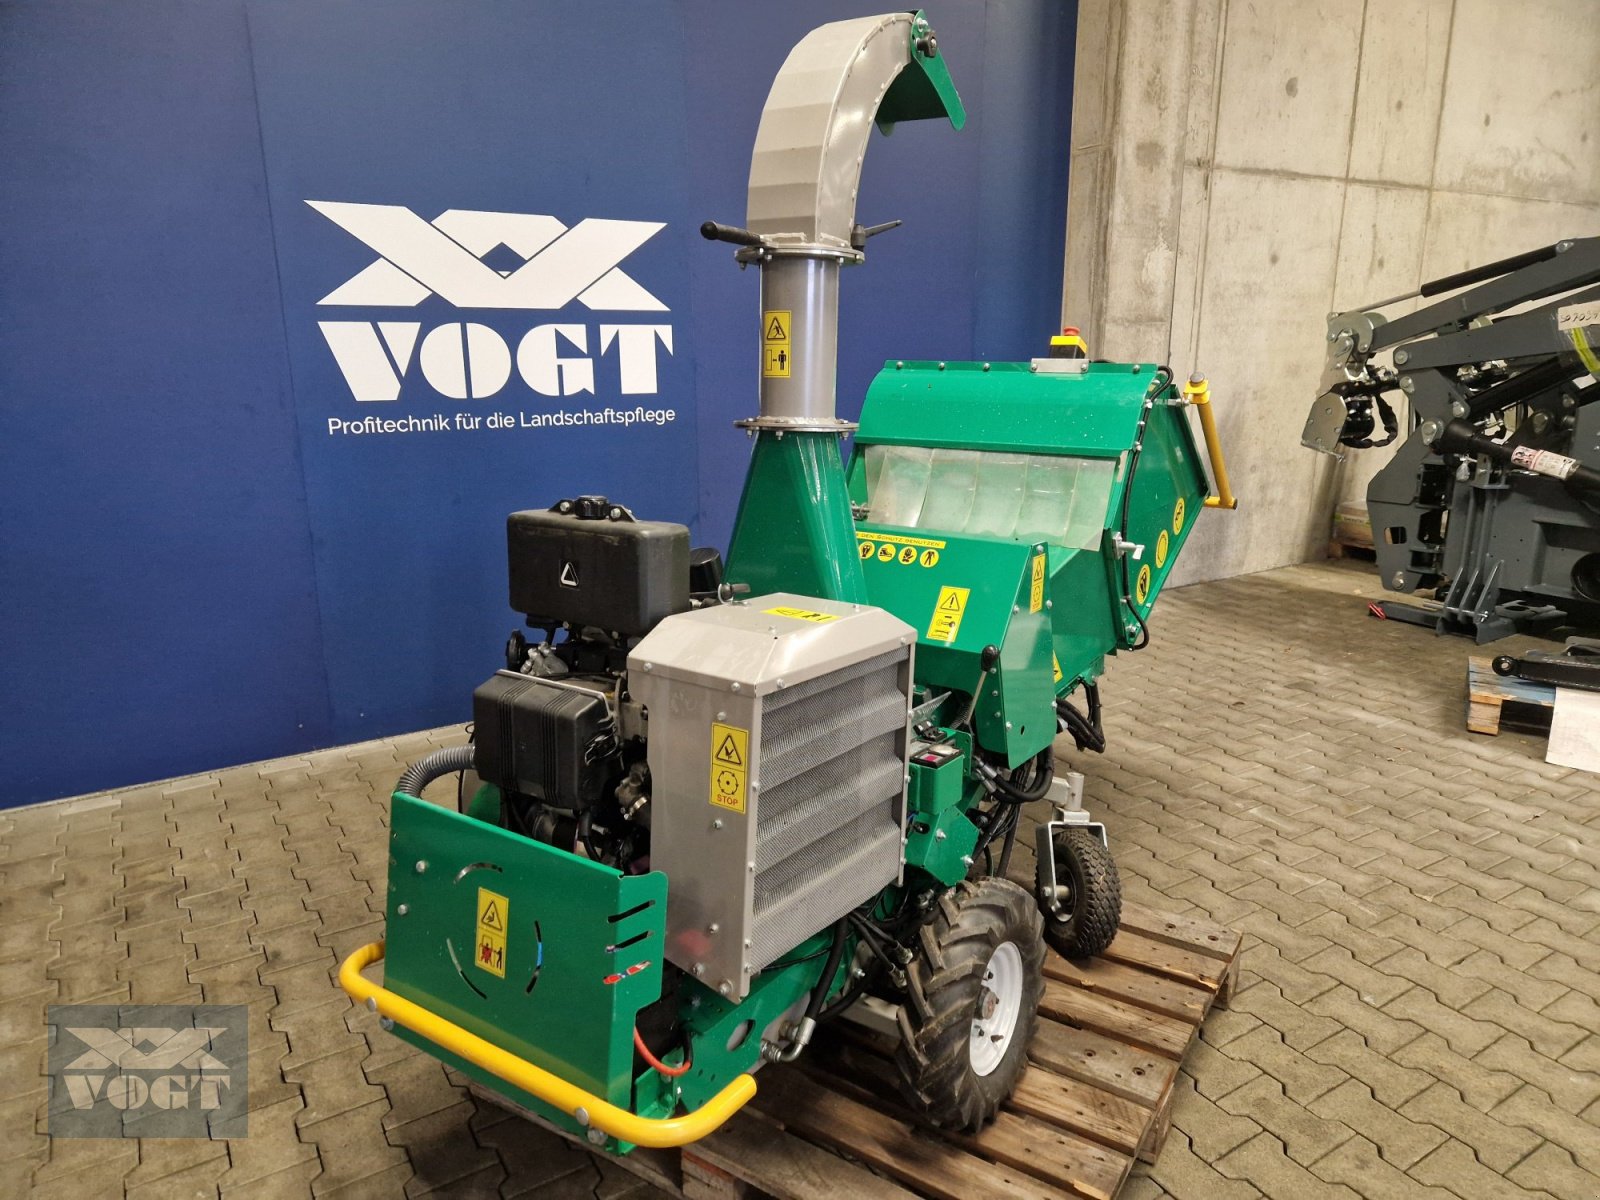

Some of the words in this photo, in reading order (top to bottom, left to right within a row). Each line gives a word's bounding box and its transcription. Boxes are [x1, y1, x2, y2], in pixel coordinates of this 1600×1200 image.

[317, 321, 674, 402] VOGT
[327, 414, 451, 435] Profitechnik
[454, 412, 482, 431] für
[486, 411, 515, 429] die
[519, 406, 676, 427] Landschaftspflege
[716, 793, 738, 806] STOP
